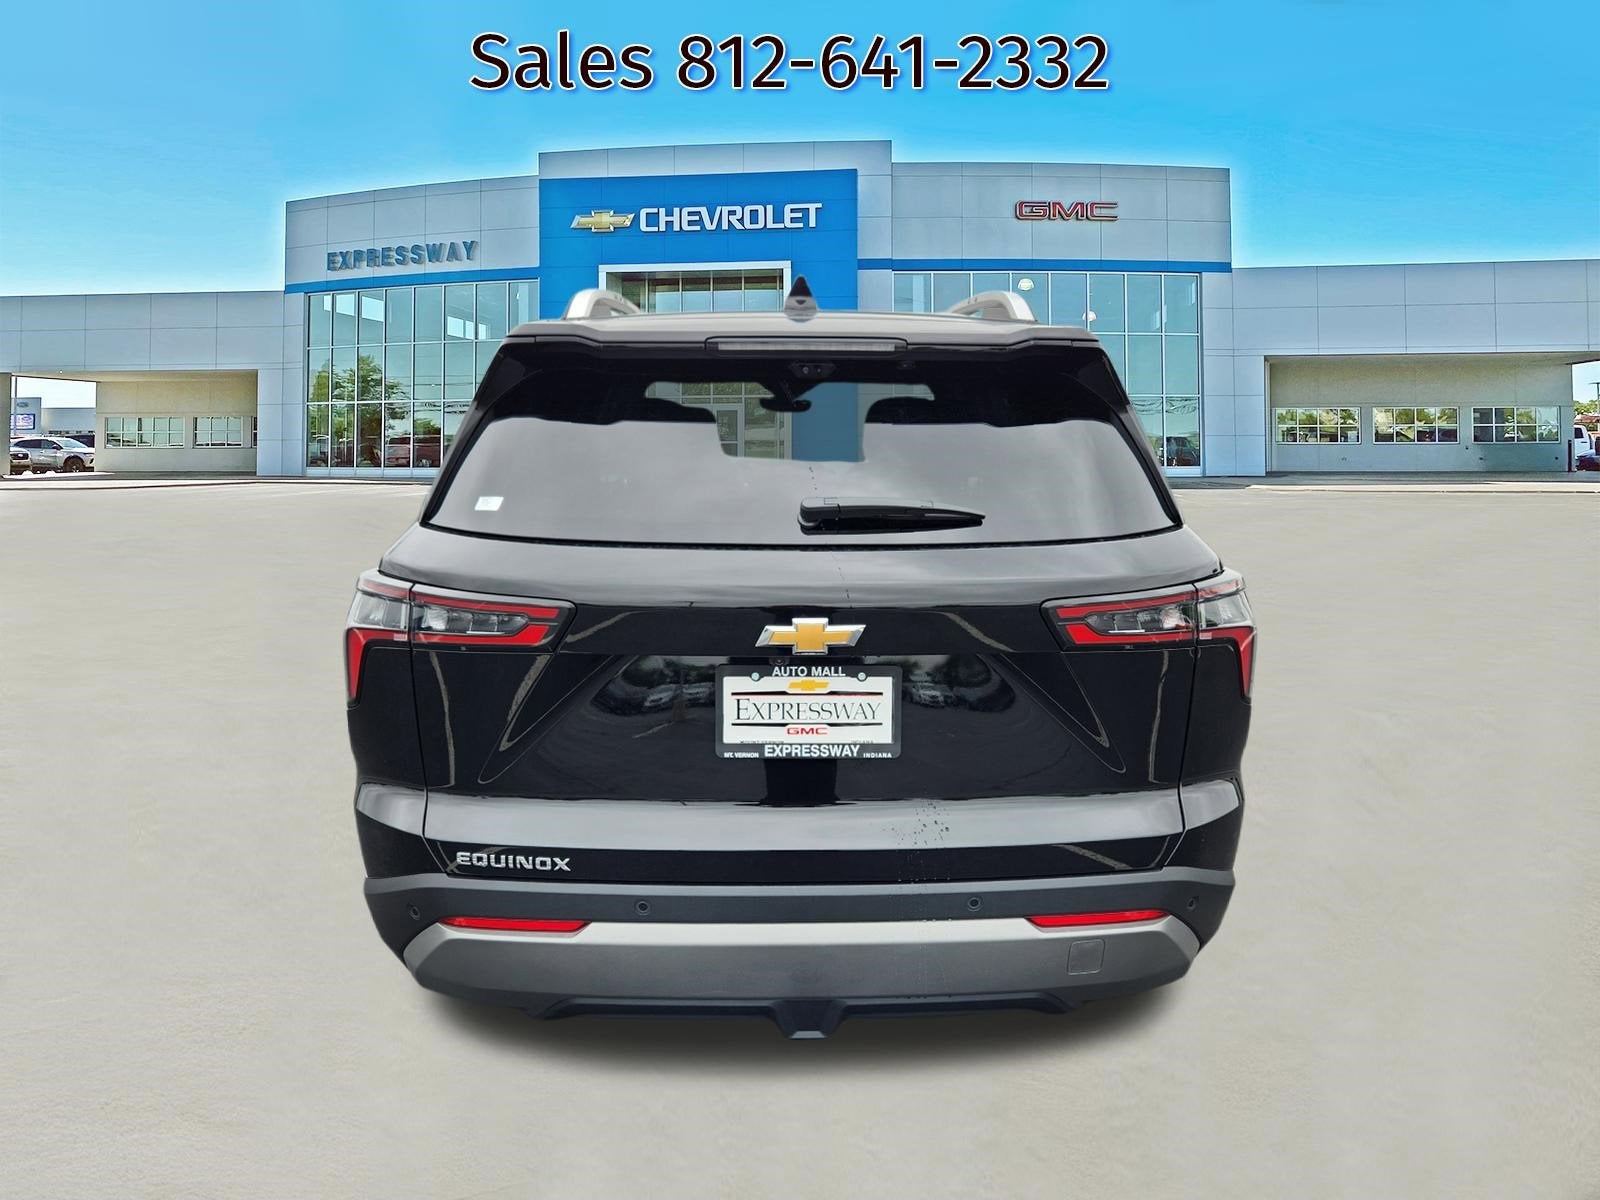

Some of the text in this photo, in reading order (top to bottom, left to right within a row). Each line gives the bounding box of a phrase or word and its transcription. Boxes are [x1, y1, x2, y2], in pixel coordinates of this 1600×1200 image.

[639, 202, 823, 232] CHEVROLET
[1015, 200, 1119, 221] GMC
[327, 240, 478, 271] EXPRESSWAY
[772, 666, 846, 677] AUTO MALL
[735, 698, 881, 720] EXPRESSWAY
[787, 727, 829, 735] GMC
[764, 744, 860, 758] EXPRESSWAY
[456, 851, 571, 871] EQUINOX
